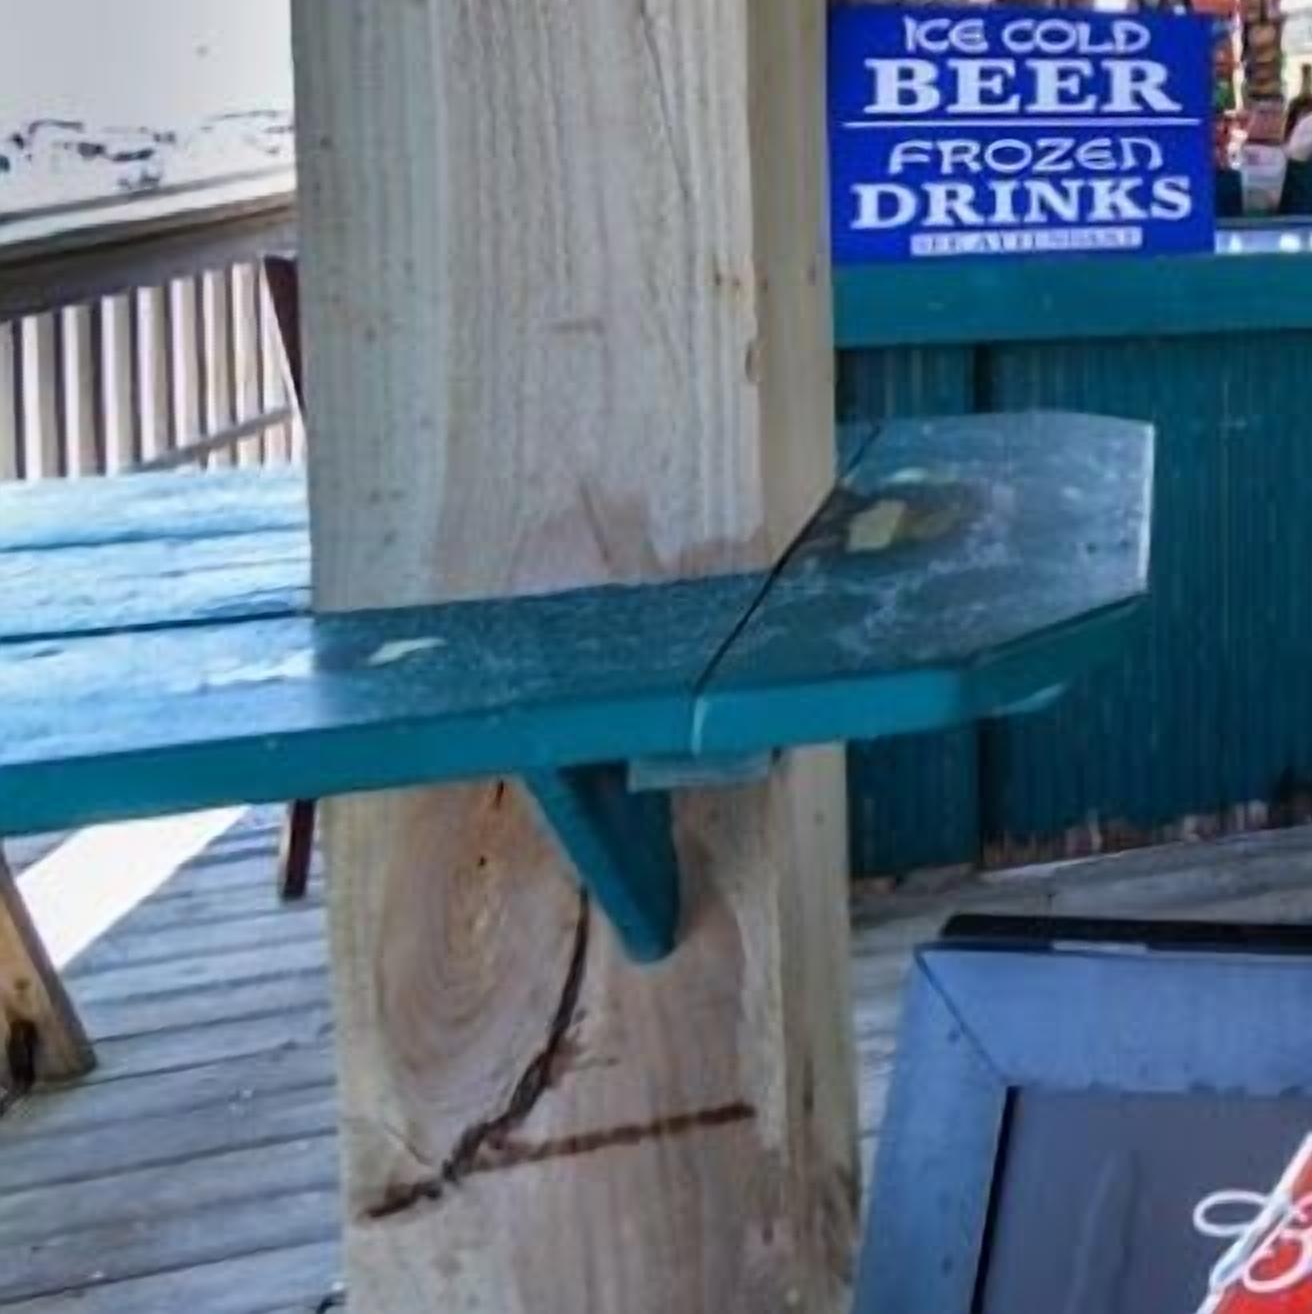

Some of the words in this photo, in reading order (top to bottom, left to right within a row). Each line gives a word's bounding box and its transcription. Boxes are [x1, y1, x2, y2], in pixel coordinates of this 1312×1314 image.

[903, 14, 988, 53] ICE
[1001, 16, 1151, 54] COLD
[863, 57, 1183, 115] BEER
[887, 136, 1165, 176] FROZEN
[850, 175, 1192, 230] DRINKS
